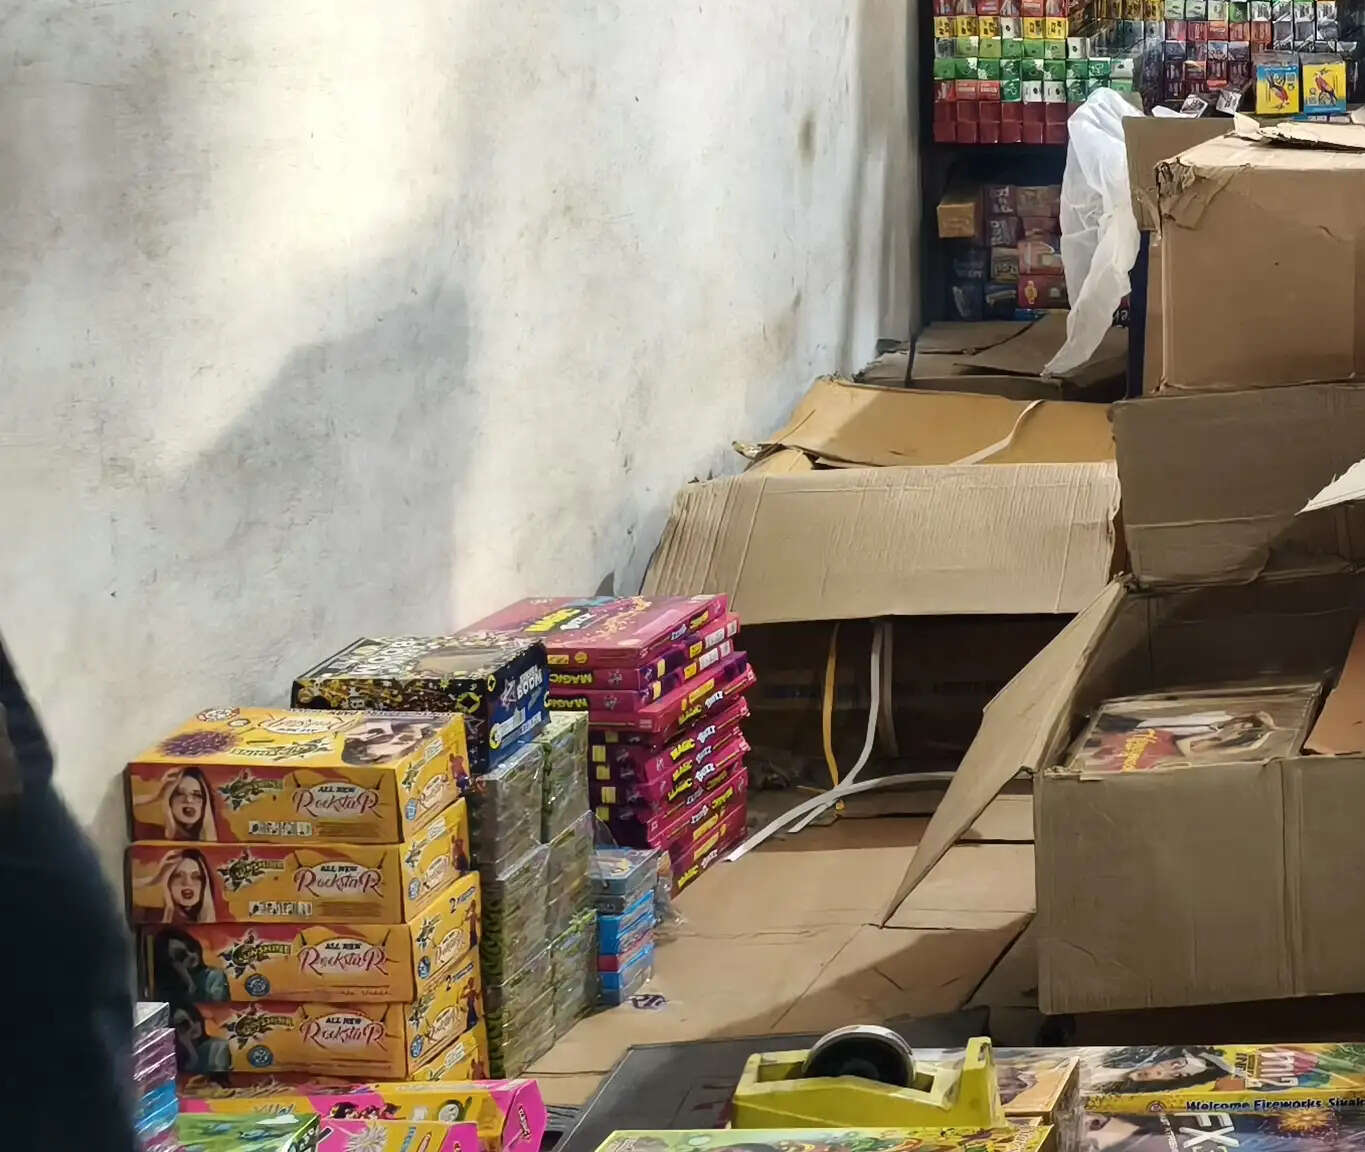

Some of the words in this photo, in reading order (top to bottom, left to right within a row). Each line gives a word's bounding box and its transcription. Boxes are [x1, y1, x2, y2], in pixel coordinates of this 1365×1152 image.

[549, 672, 593, 685] MAGIC
[1186, 1098, 1251, 1113] Welcome
[1253, 1097, 1323, 1112] Fireworks
